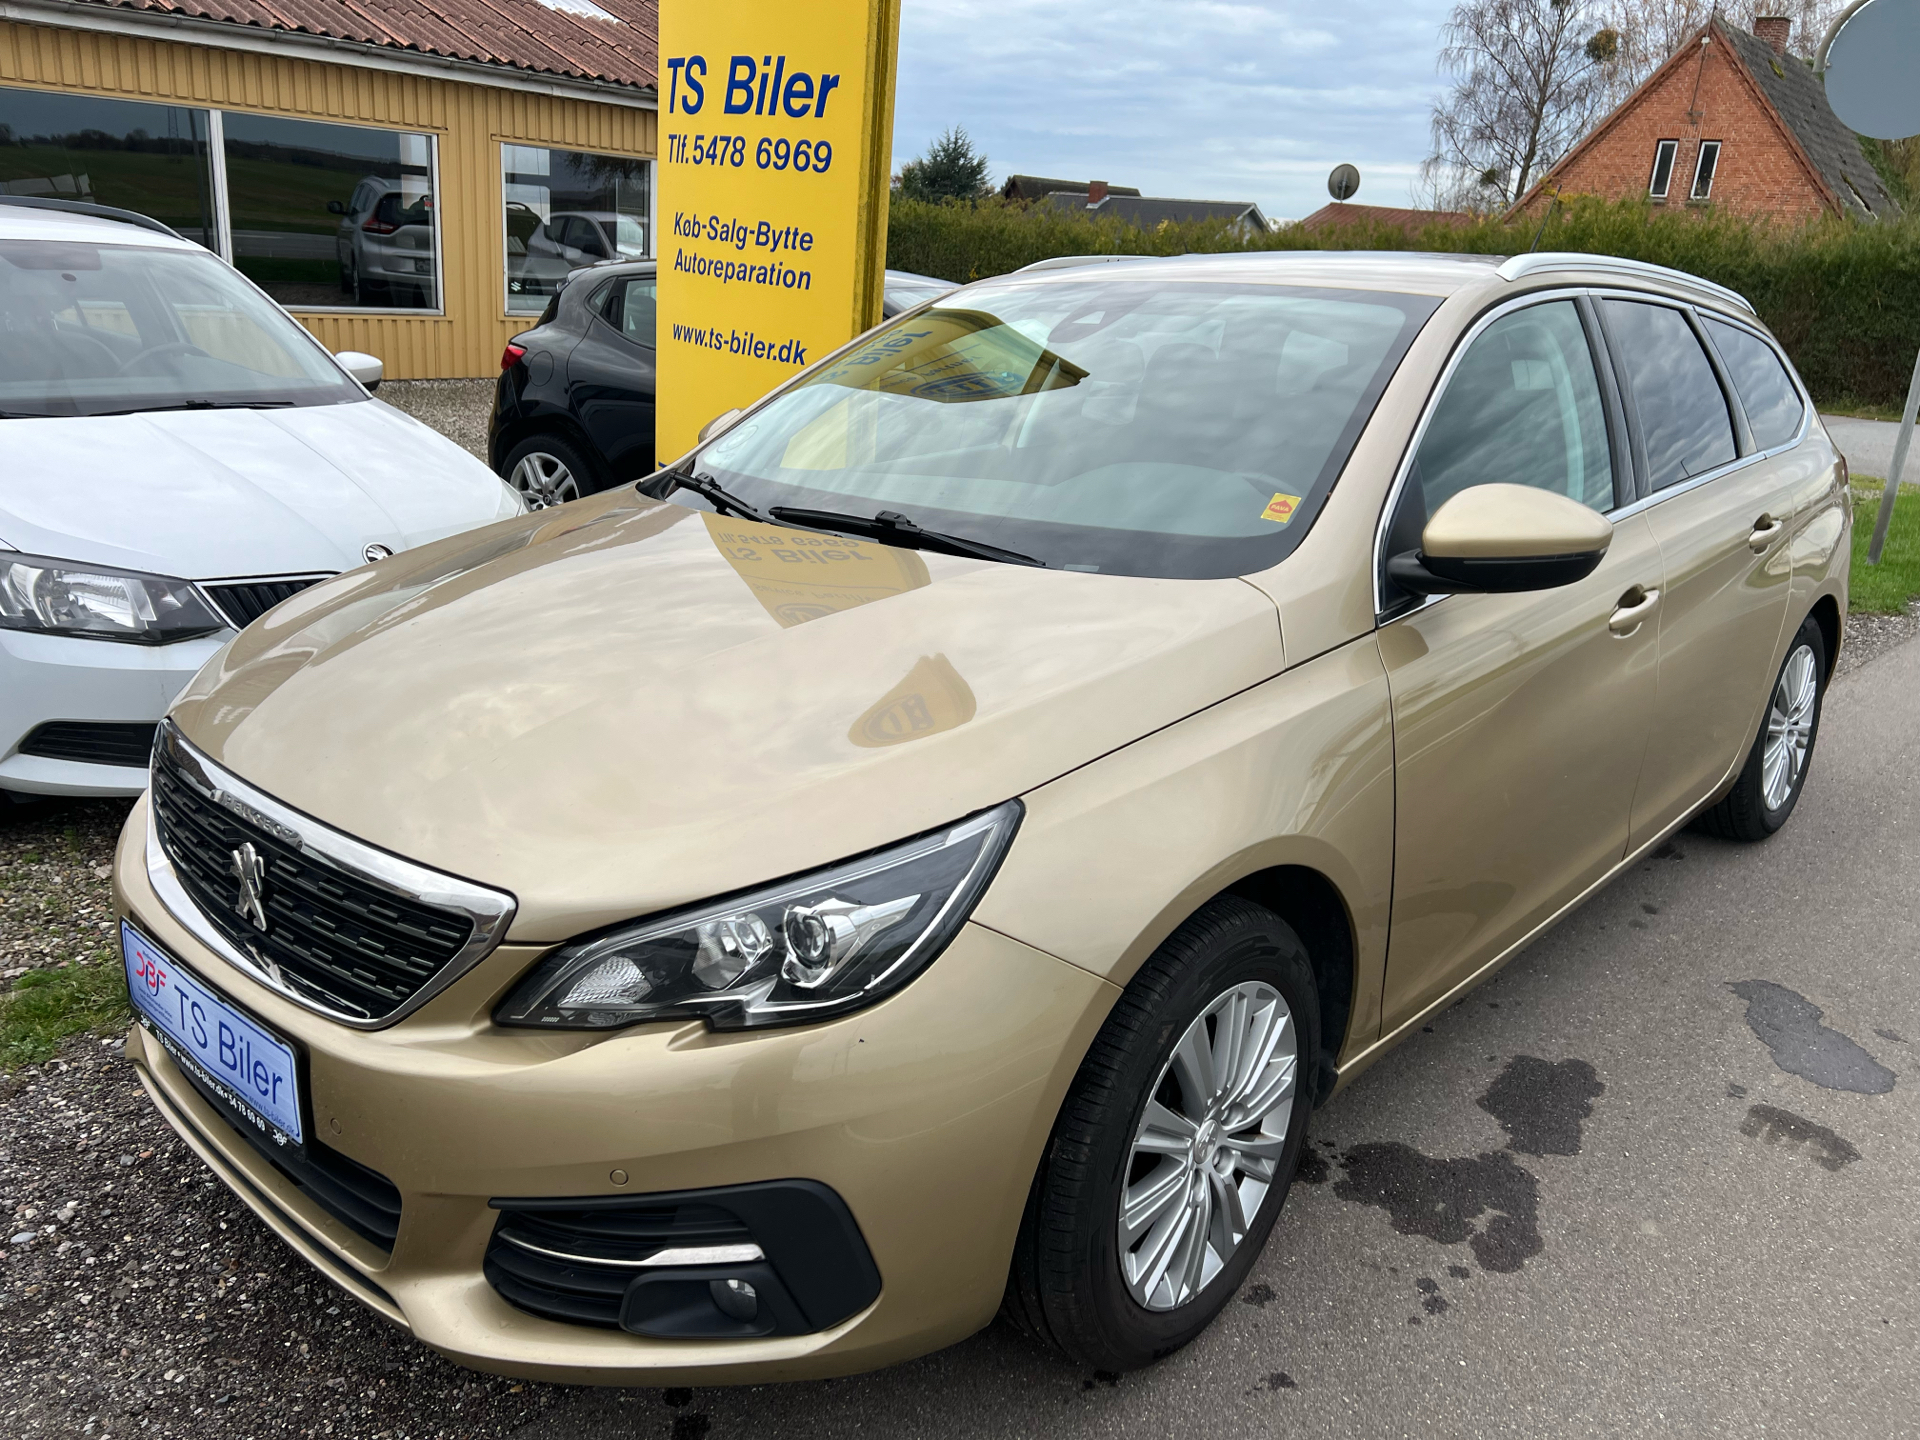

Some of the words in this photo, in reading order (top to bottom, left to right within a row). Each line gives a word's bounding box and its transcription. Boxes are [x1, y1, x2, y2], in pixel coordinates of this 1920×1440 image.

[667, 55, 707, 115] TS
[723, 55, 841, 118] Biler
[756, 137, 833, 174] 6969
[673, 248, 812, 290] Autoreparation
[672, 323, 808, 366] www.ts-biler.dk
[1271, 504, 1290, 512] PAVA
[223, 793, 294, 841] PEUGEOT
[174, 983, 208, 1050] TS
[218, 1019, 283, 1105] Biler
